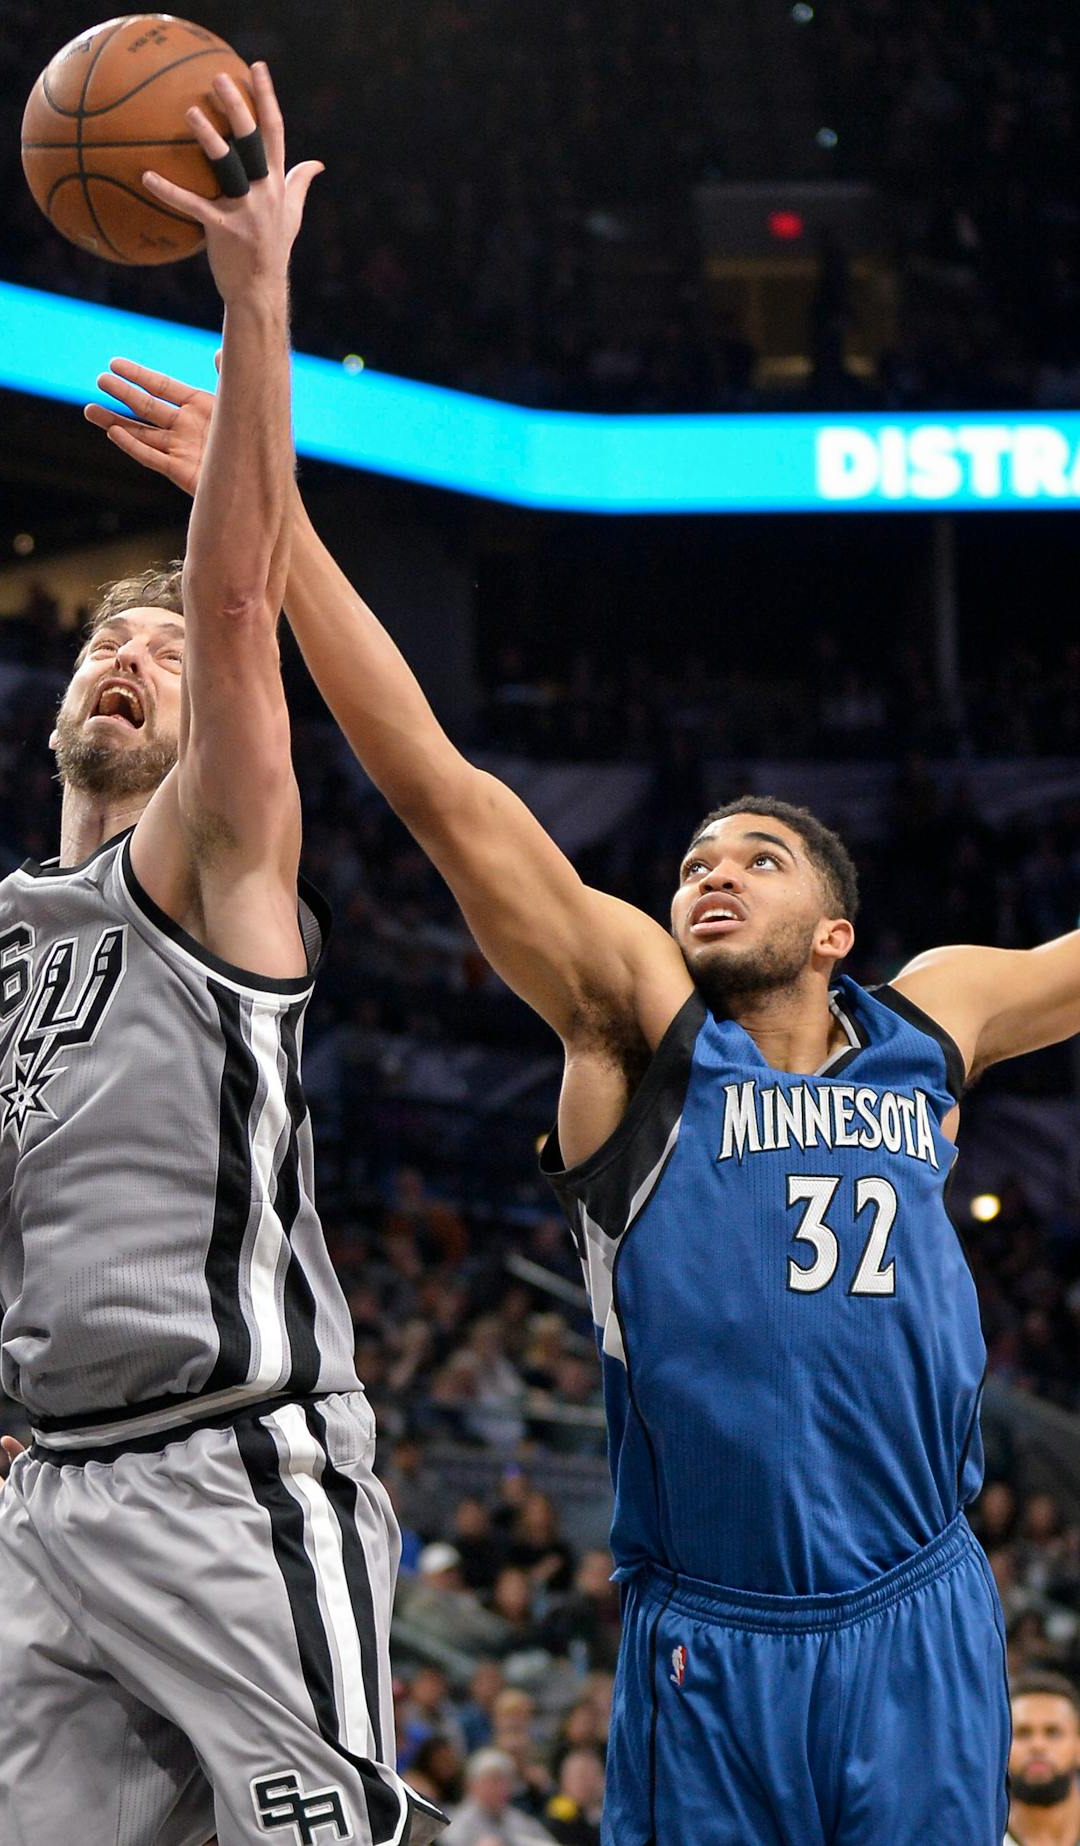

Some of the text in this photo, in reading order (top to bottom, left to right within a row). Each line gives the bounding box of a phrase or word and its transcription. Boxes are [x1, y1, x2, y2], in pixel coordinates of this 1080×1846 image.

[816, 423, 1080, 500] DISTR
[717, 1080, 940, 1172] MINNESOTA
[786, 1173, 897, 1297] 32
